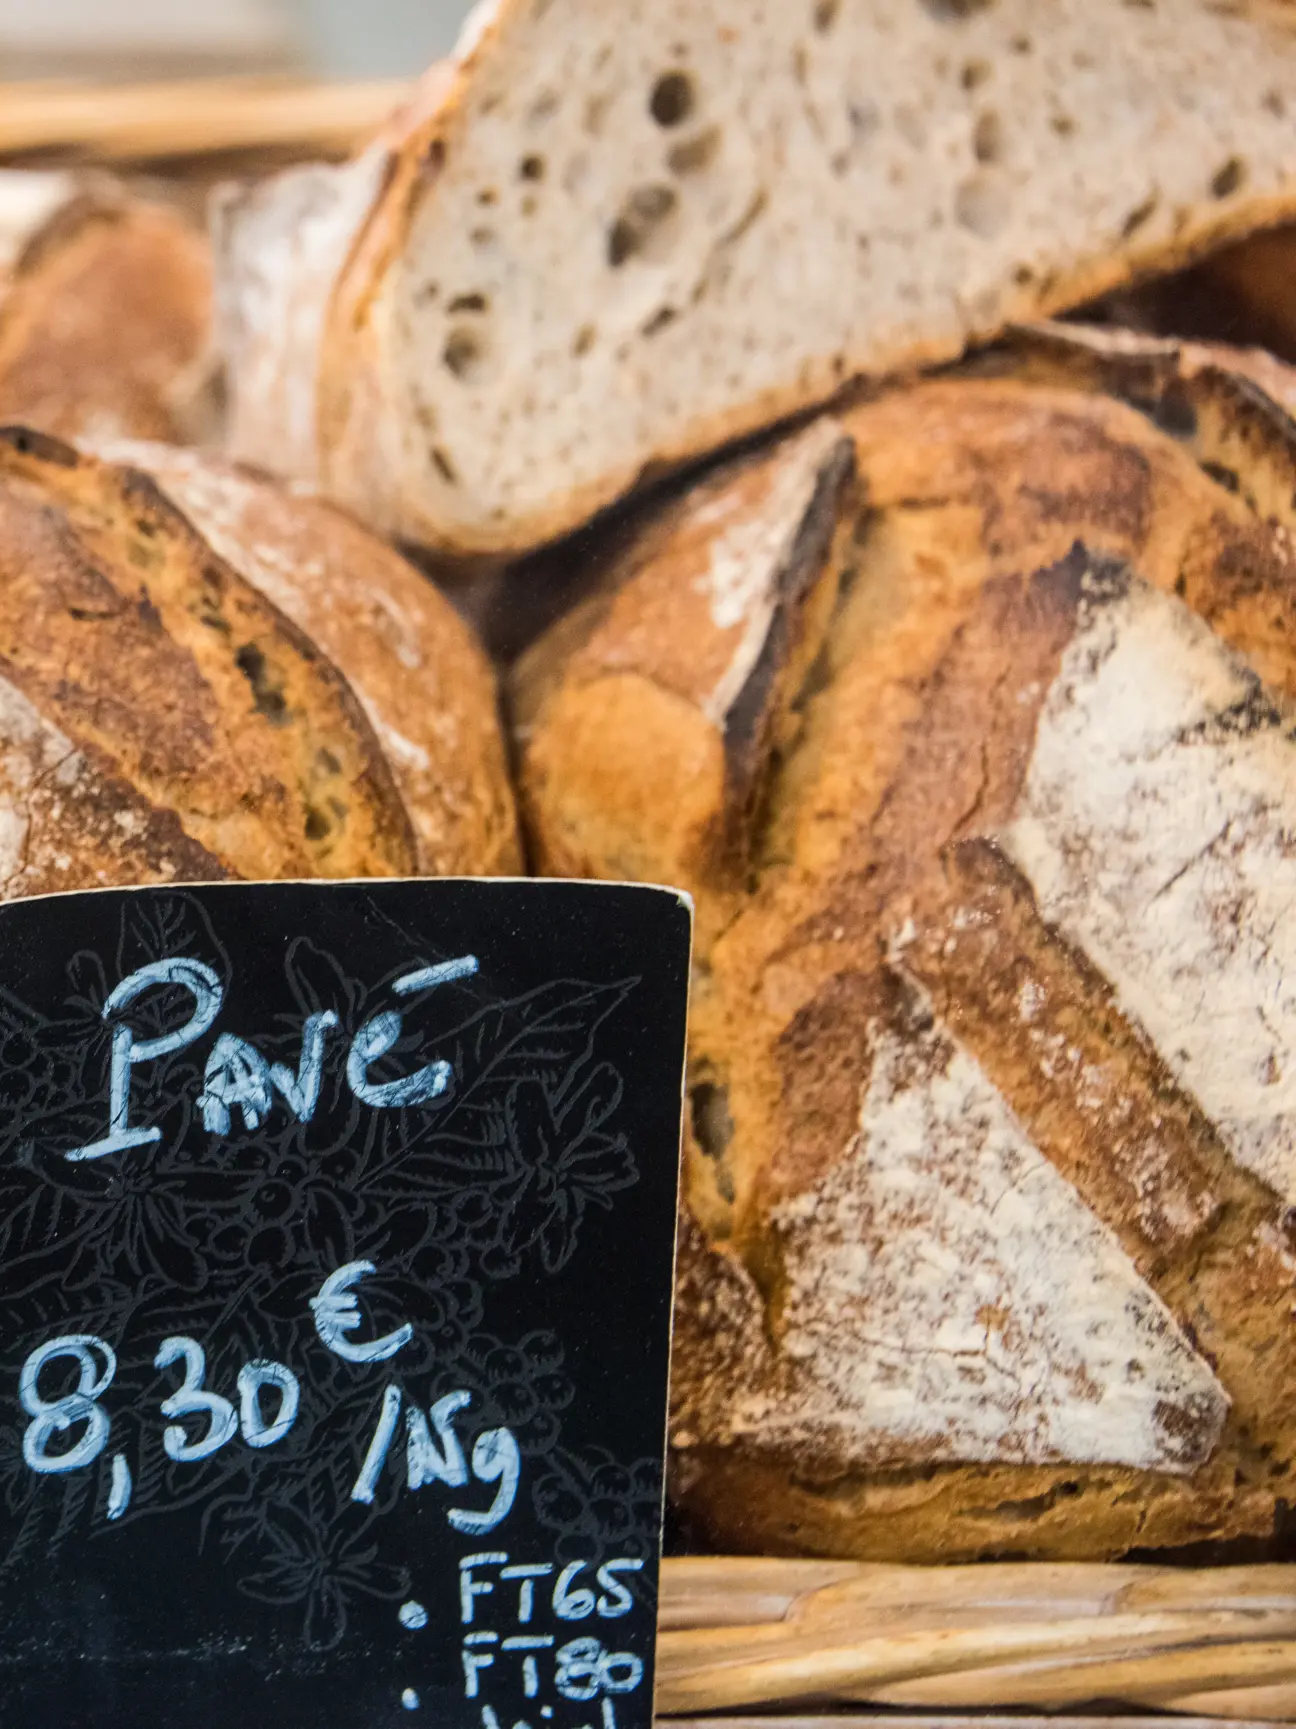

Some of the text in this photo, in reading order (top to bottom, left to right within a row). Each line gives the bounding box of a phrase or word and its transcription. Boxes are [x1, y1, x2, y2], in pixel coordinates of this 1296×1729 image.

[19, 1334, 300, 1520] 8,30
[309, 1259, 413, 1363] €
[459, 1551, 645, 1624] FT65
[462, 1630, 644, 1700] FT80
